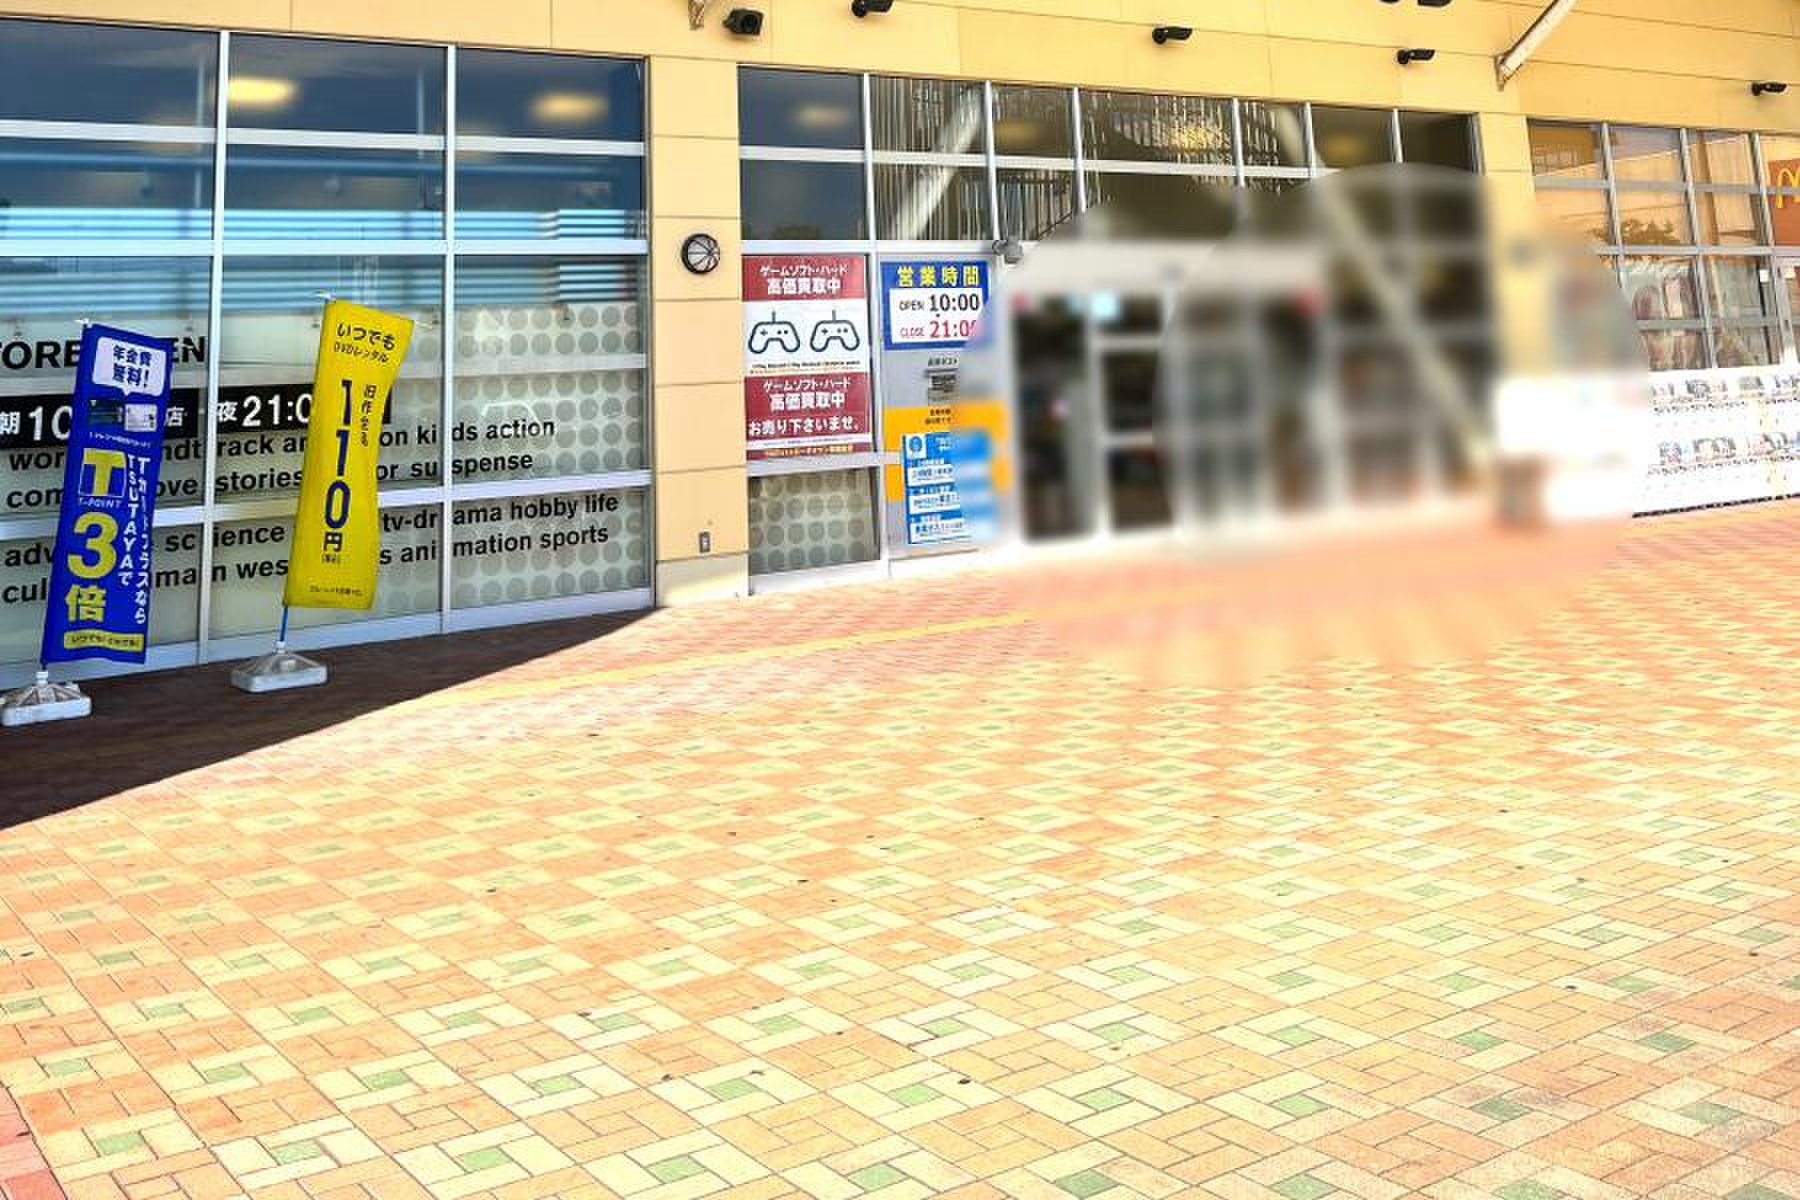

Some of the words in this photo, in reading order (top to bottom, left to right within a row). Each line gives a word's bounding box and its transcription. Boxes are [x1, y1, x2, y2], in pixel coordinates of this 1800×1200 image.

[767, 277, 841, 295] 高価買取中
[897, 266, 979, 287] 営業時間
[899, 301, 924, 312] OPEN
[929, 294, 979, 313] 10:00
[336, 323, 395, 351] いつでも
[901, 327, 925, 338] CLOSE
[0, 339, 81, 370] ORE
[334, 341, 389, 363] DVDレンタル
[764, 377, 851, 392] ゲームソフト・ハード
[769, 390, 846, 412] 高価買取中
[485, 418, 555, 440] action
[156, 477, 198, 497] ove
[510, 497, 579, 520] hobby
[585, 493, 619, 513] life
[540, 525, 609, 550] sports
